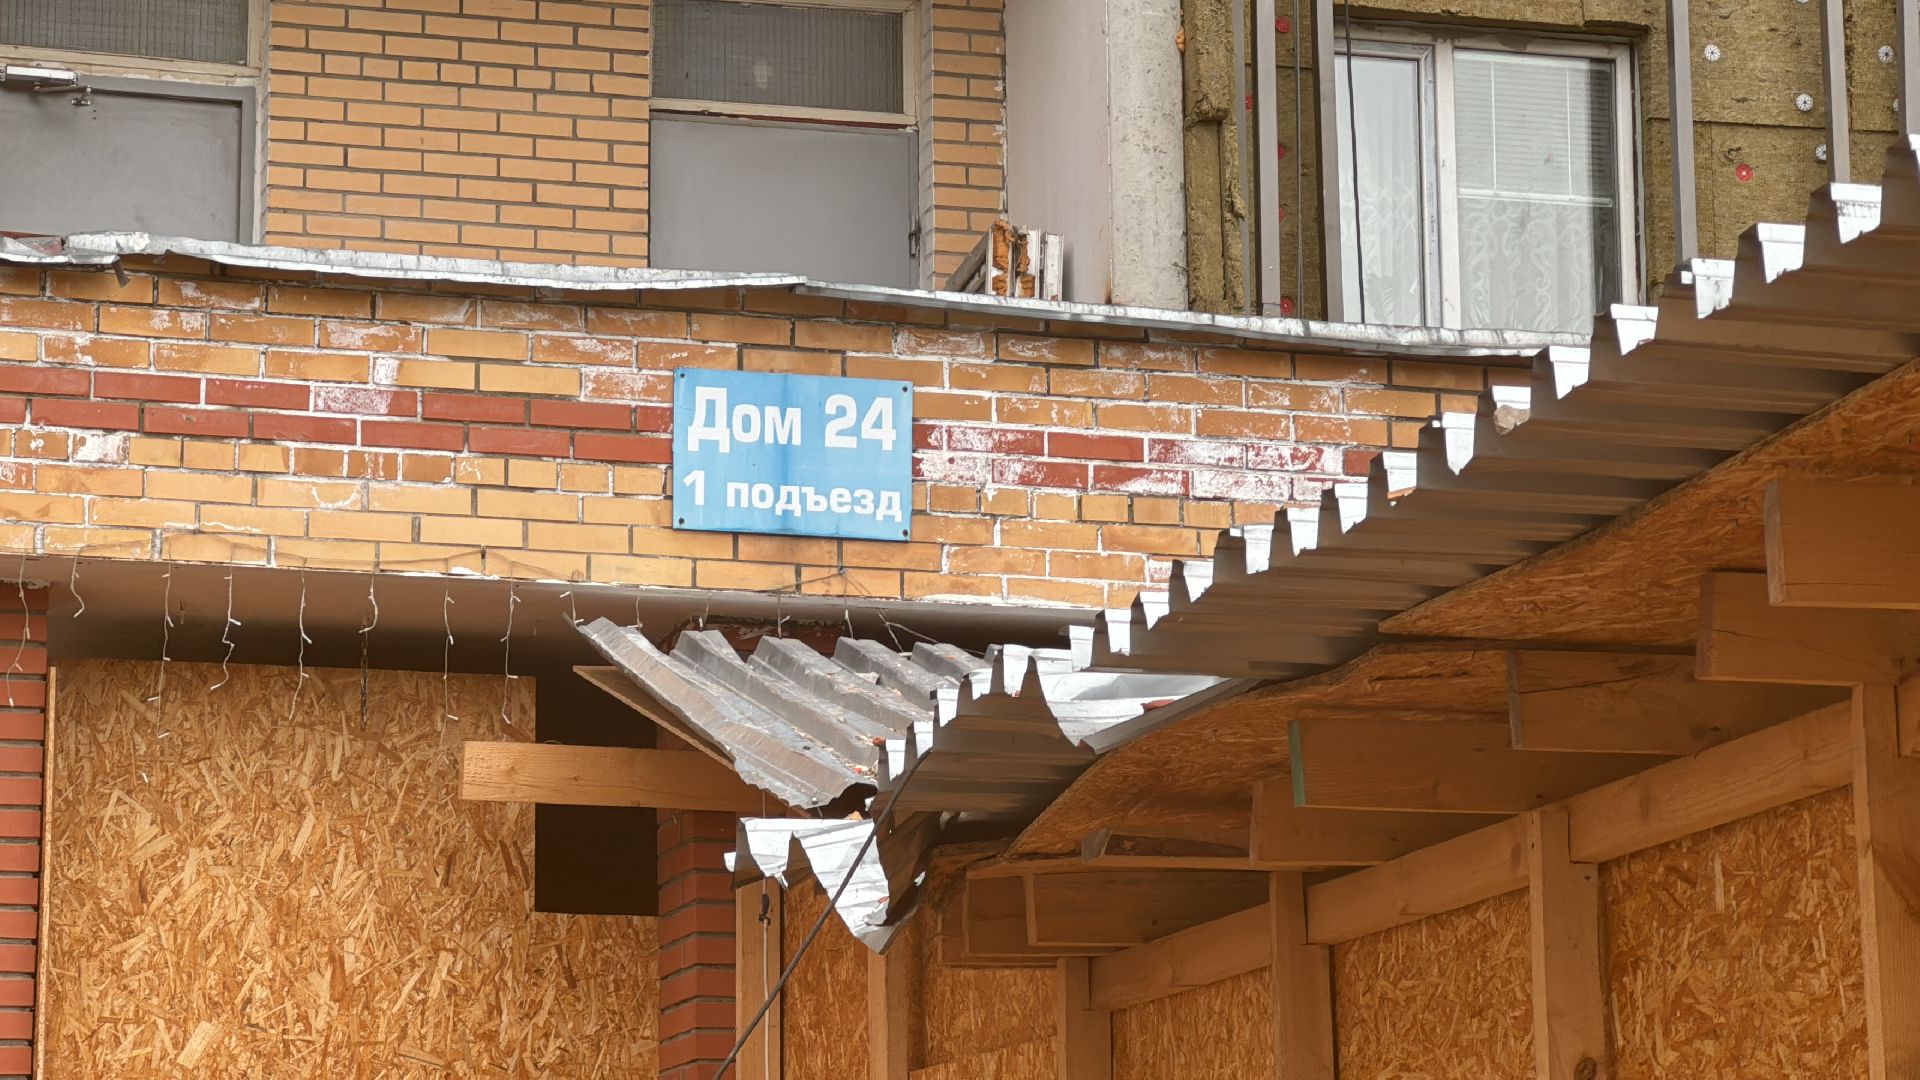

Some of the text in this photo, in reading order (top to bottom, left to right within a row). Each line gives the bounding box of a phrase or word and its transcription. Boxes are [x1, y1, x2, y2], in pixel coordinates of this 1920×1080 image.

[687, 386, 897, 454] Дом 24
[682, 469, 902, 523] 1 подъезд
